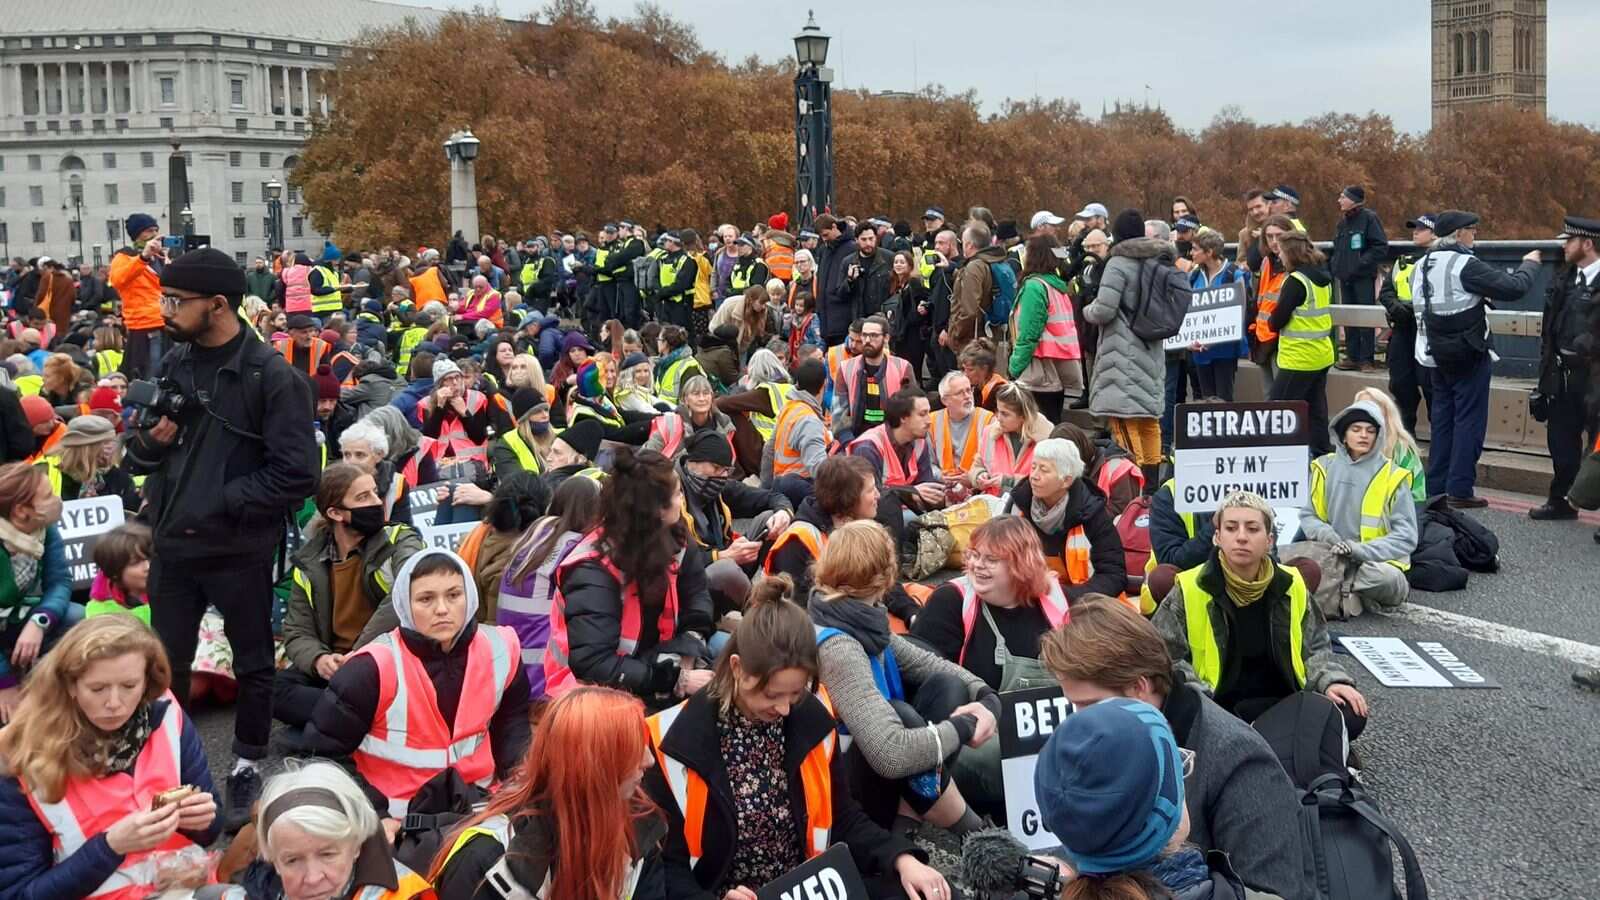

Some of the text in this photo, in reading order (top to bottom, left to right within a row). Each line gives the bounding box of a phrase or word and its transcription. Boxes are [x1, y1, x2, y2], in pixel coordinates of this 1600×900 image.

[1192, 288, 1235, 307] RAYED
[1185, 314, 1217, 327] BY MY
[1168, 325, 1236, 344] GOVERNMENT
[1187, 409, 1297, 437] BETRAYED
[1215, 455, 1268, 474] BY MY
[68, 562, 98, 582] ME
[1416, 641, 1486, 683] BETRAYED
[1014, 697, 1076, 739] BET
